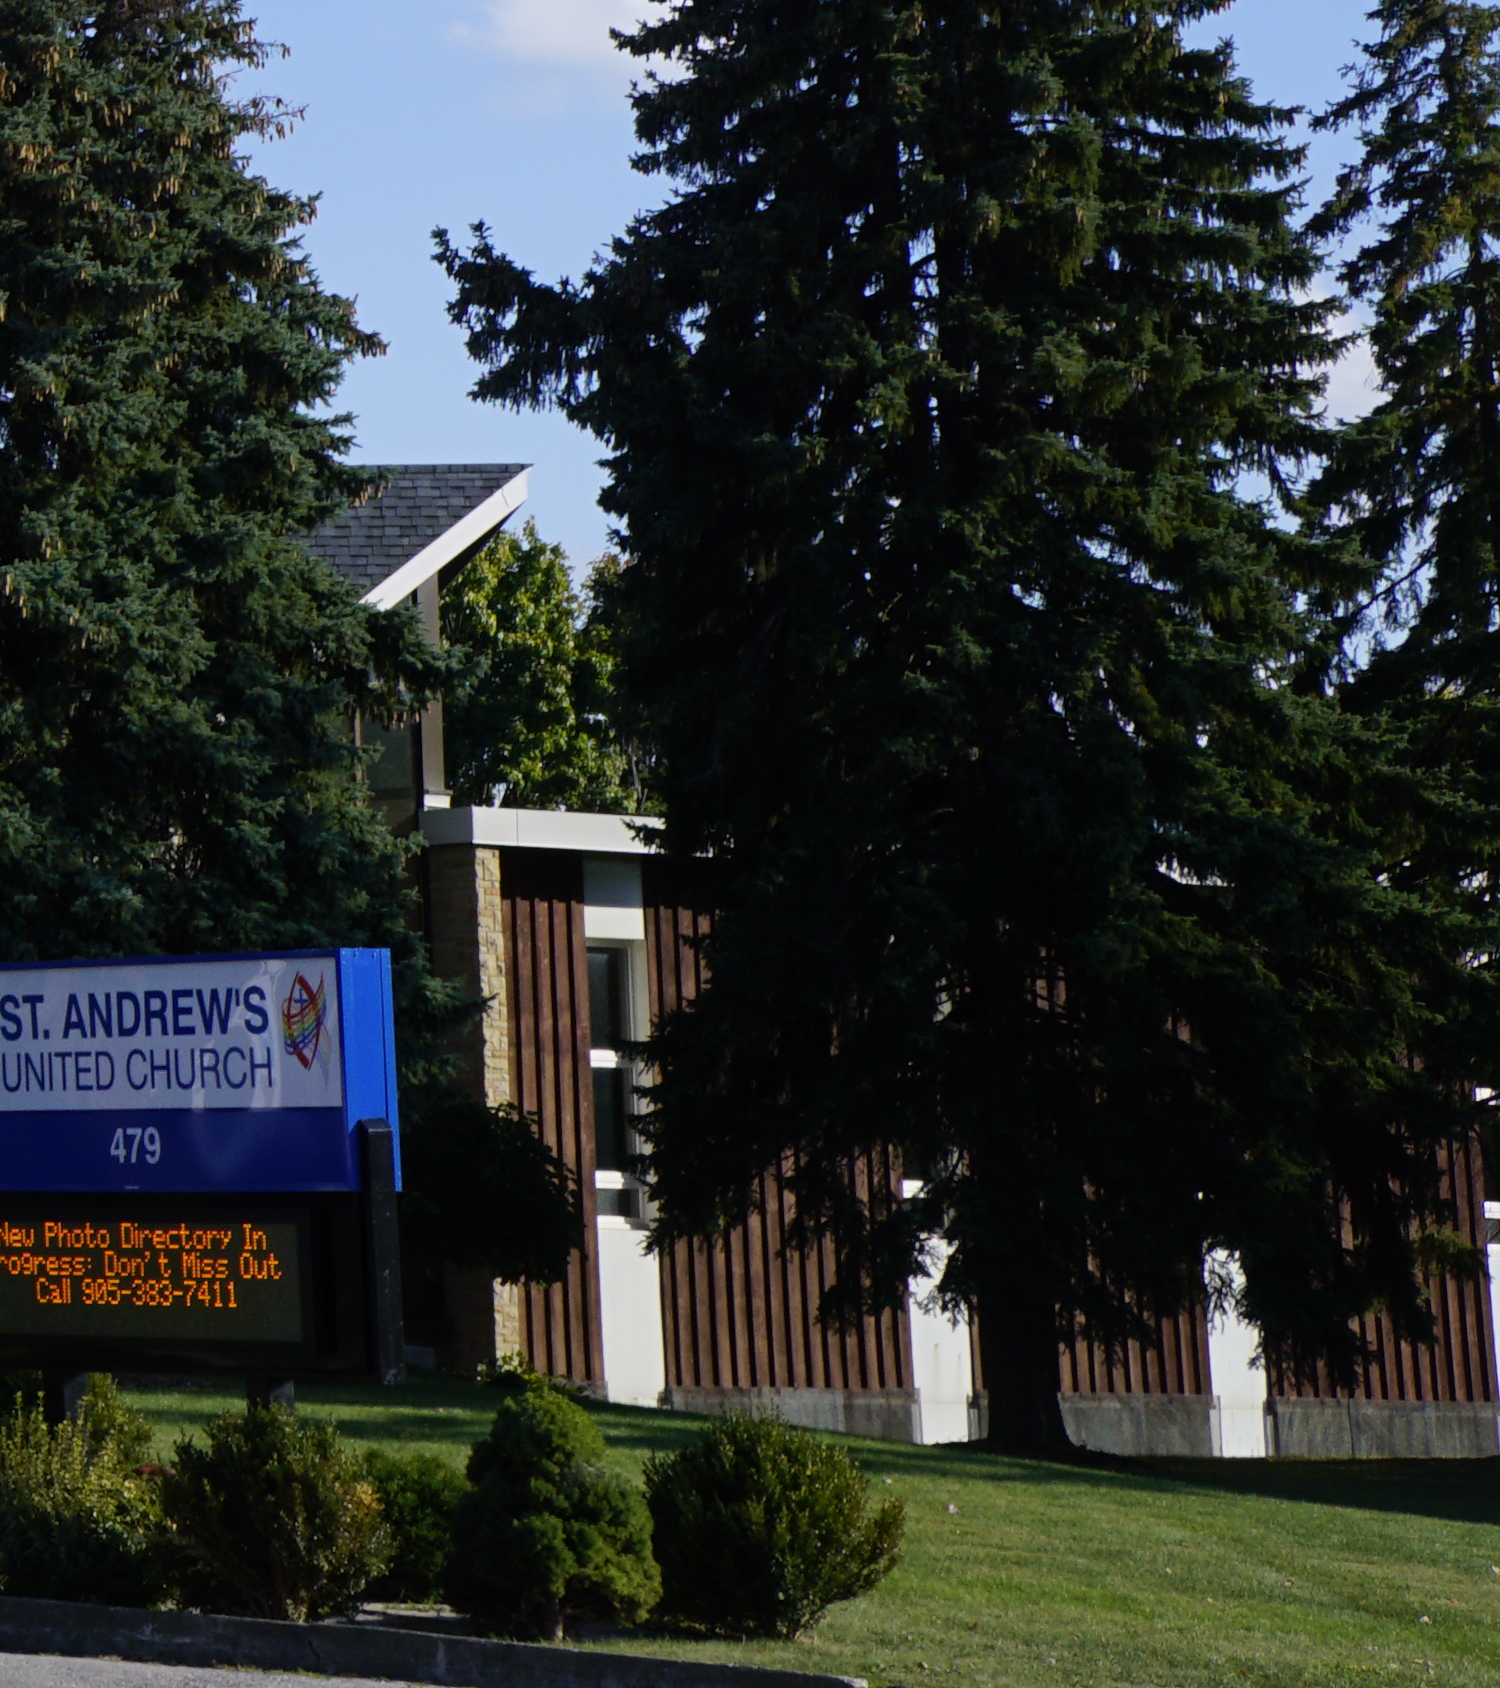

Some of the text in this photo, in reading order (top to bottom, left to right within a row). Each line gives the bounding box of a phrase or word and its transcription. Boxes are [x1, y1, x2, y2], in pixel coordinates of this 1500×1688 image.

[61, 985, 269, 1039] ANDREW'S
[1, 1046, 273, 1093] UNITED CHURCH
[110, 1126, 161, 1165] 479
[44, 1221, 110, 1248] Photo
[120, 1222, 232, 1250] Directory
[242, 1223, 267, 1250] In
[104, 1250, 171, 1278] Don't
[182, 1251, 229, 1279] Miss
[239, 1252, 282, 1280] Out
[36, 1277, 238, 1308] Call 905-383-7411
